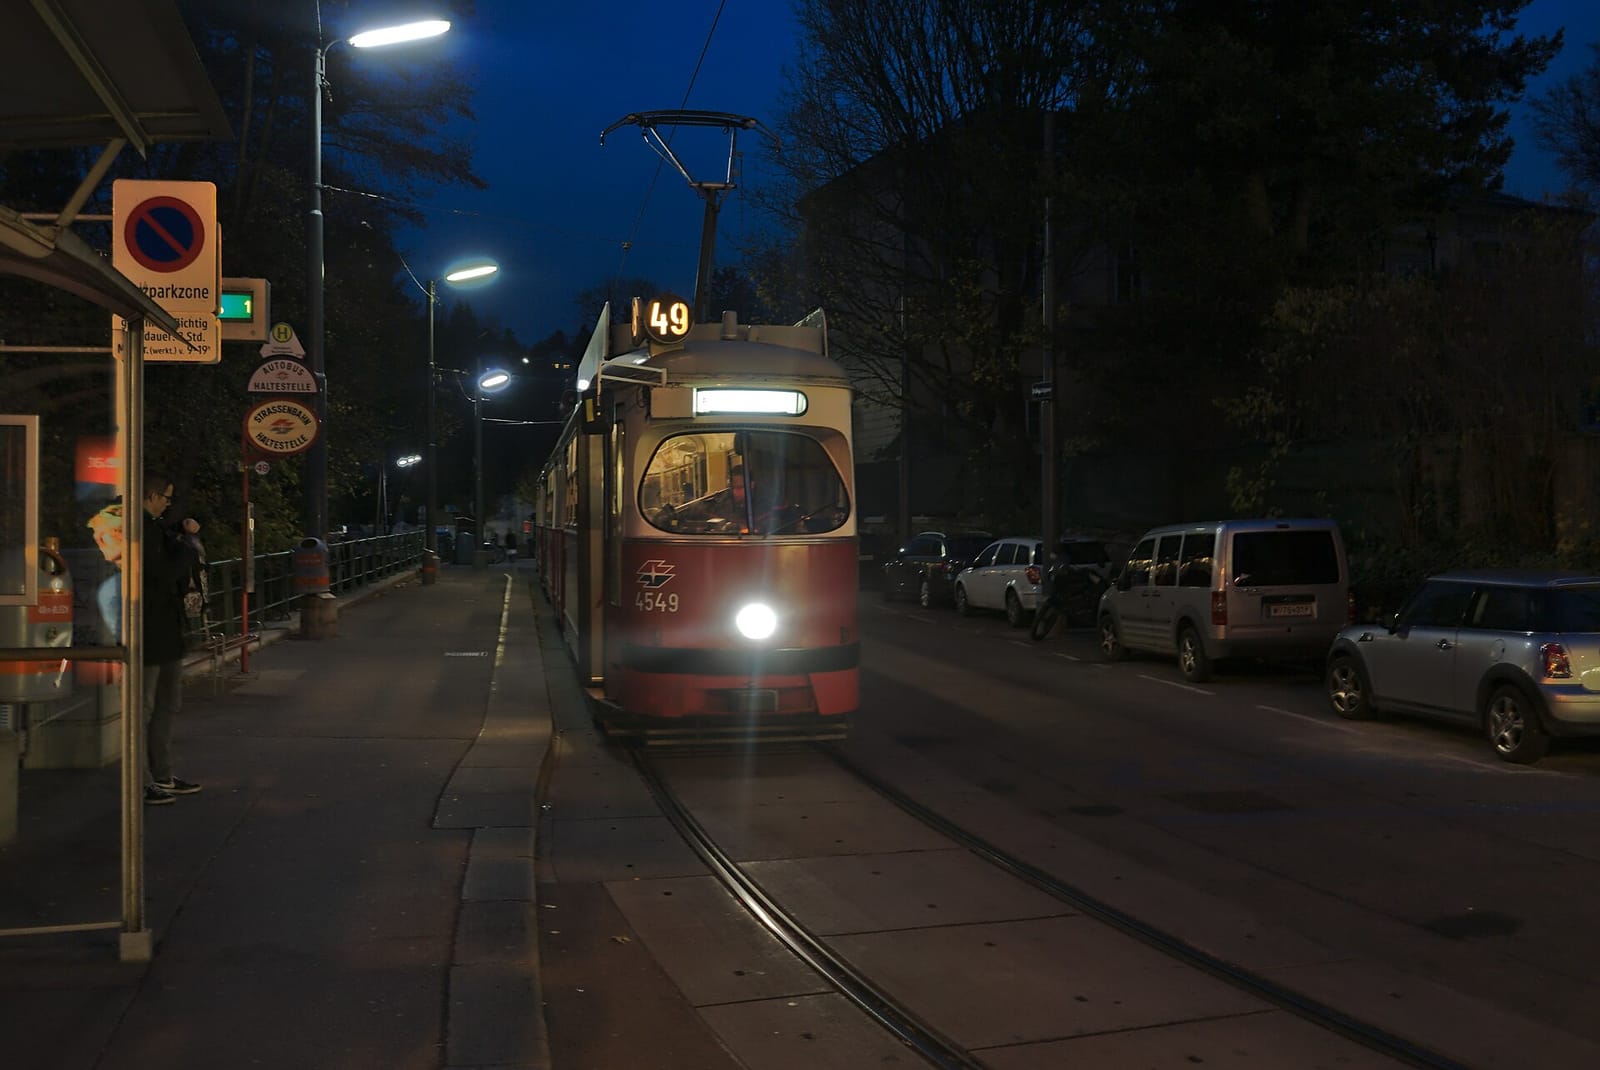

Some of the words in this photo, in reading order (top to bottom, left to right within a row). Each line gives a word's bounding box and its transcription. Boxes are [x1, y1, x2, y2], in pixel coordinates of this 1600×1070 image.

[650, 302, 689, 335] 49
[187, 332, 206, 342] Std.
[277, 327, 288, 340] H
[262, 361, 304, 376] AUTOBUS
[254, 382, 312, 392] HALTESTELLE
[254, 405, 312, 425] STRASSENBAHN
[255, 432, 309, 450] HALTESTELLE
[635, 592, 679, 612] 4549
